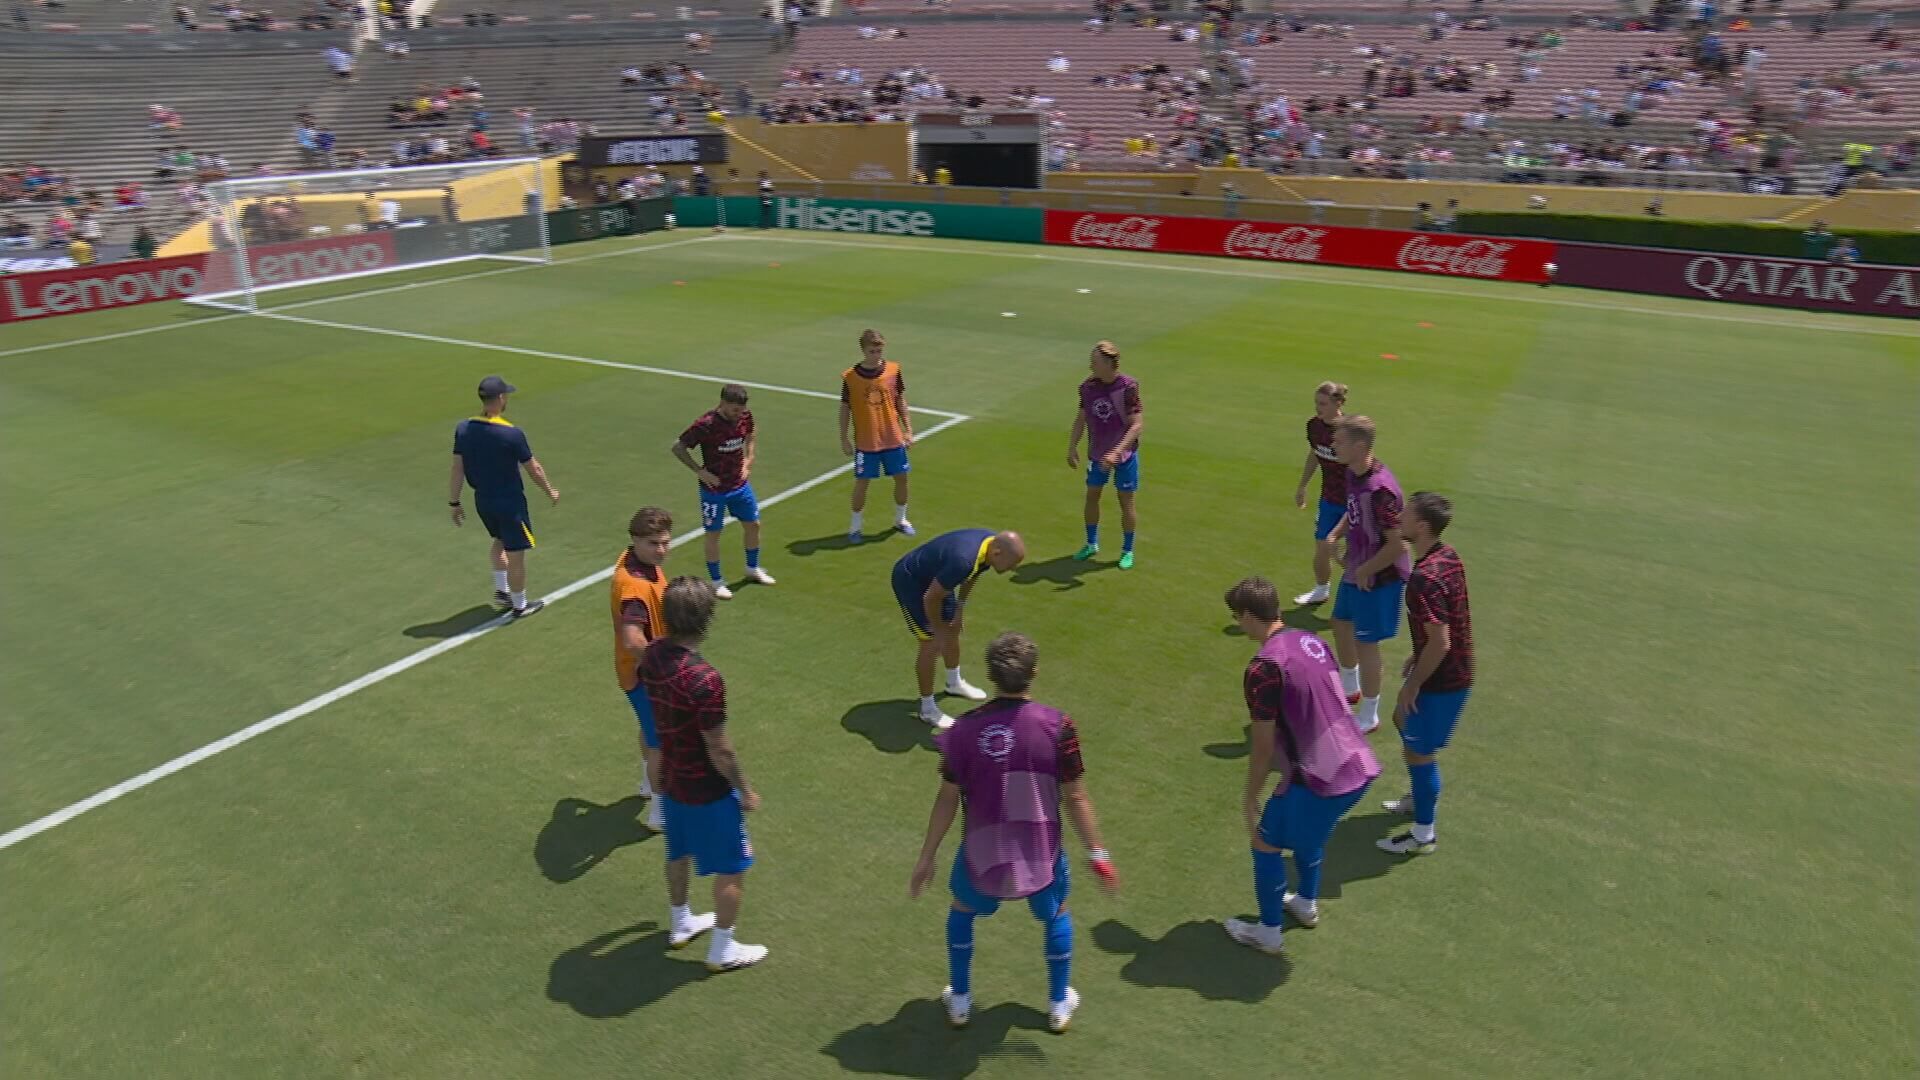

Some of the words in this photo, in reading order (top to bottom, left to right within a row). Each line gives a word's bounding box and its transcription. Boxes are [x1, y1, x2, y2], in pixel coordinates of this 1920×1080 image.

[960, 116, 994, 126] EXIT
[607, 139, 699, 164] #FIFACWC
[775, 198, 936, 236] Hisense
[1070, 214, 1162, 250] Coca-Cola
[468, 224, 512, 249] PIF
[1225, 223, 1328, 262] Coca-Cola
[230, 243, 384, 286] Lenovo
[1396, 235, 1516, 277] Coca-Cola
[4, 265, 202, 320] Lenovo
[1684, 256, 1860, 304] QATAR
[703, 502, 718, 519] 21
